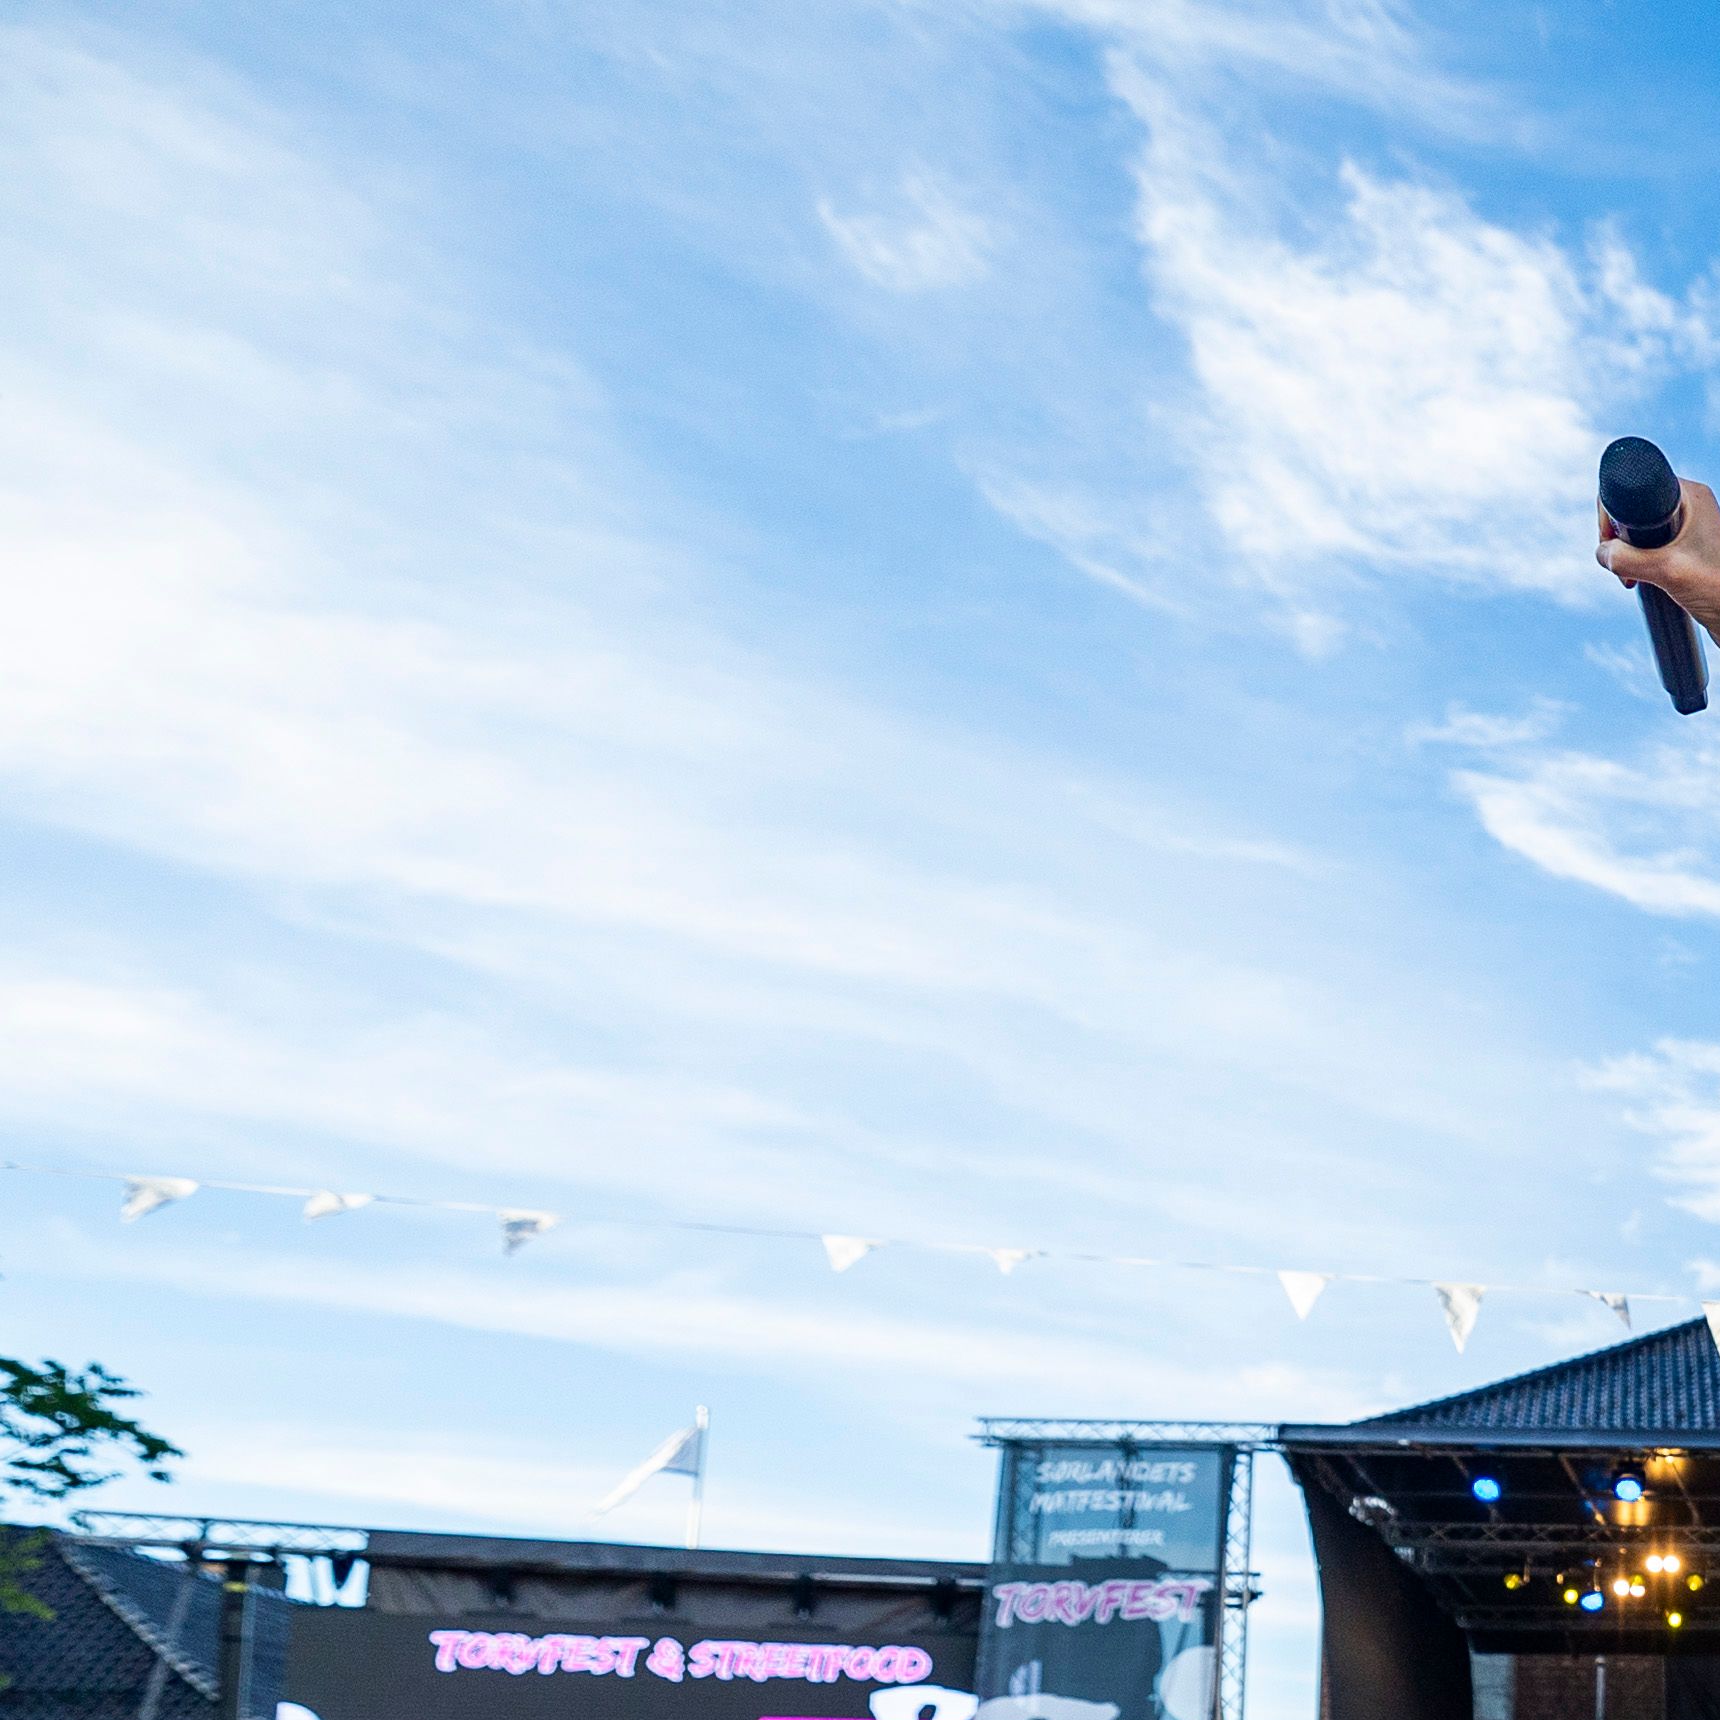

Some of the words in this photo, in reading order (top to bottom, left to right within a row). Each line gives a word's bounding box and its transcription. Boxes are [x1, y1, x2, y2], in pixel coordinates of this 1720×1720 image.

[993, 1573, 1213, 1628] TORVFEST
[429, 1630, 650, 1677] TORVFEST
[645, 1636, 686, 1683] &
[687, 1639, 933, 1684] STREETFOOD
